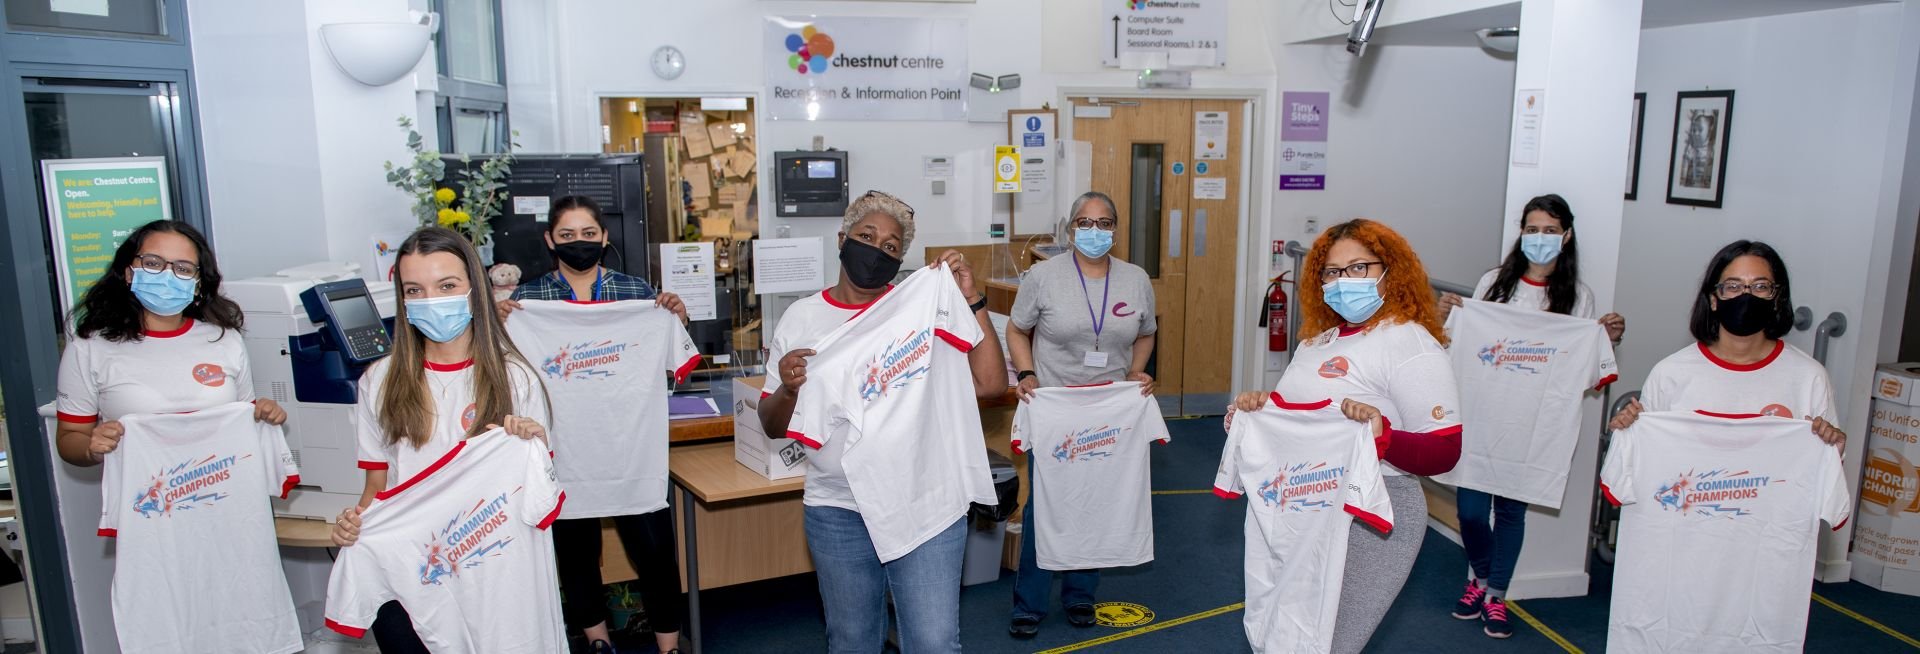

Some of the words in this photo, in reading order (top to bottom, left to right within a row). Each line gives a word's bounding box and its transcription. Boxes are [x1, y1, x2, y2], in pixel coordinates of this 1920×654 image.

[1128, 16, 1164, 24] Computer
[1166, 16, 1184, 24] Suite
[1128, 28, 1149, 36] Board
[1152, 28, 1173, 36] Room
[1128, 40, 1162, 48] Sessional
[832, 54, 898, 68] chestnut
[900, 56, 944, 68] centre
[774, 86, 836, 101] Receion
[841, 87, 850, 99] &
[856, 87, 927, 100] Information
[931, 88, 961, 100] Point
[1291, 102, 1314, 113] Tiny
[1291, 112, 1320, 122] Steps
[64, 179, 76, 187] We
[94, 177, 128, 186] Chestnut
[128, 176, 156, 184] Centre.
[64, 190, 90, 198] Open.
[67, 200, 113, 210] Welcoming,
[114, 198, 142, 207] friendly
[68, 210, 86, 218] here
[88, 210, 96, 218] to
[71, 232, 101, 241] Monday:
[572, 343, 626, 360] COMMUNITY
[883, 327, 931, 368] COMMUNITY
[1506, 346, 1558, 355] COMMUNITY
[566, 354, 620, 371] CHAMPIONS
[880, 342, 930, 384] CHAMPIONS
[1499, 354, 1549, 362] CHAMPIONS
[1077, 428, 1122, 446] COMMUNITY
[1072, 437, 1116, 454] CHAMPIONS
[169, 456, 236, 488] COMMUNITY
[1289, 466, 1344, 486] COMMUNITY
[164, 469, 230, 502] CHAMPIONS
[1282, 479, 1338, 498] CHAMPIONS
[1696, 476, 1770, 492] COMMUNITY
[1685, 488, 1758, 504] CHAMPIONS
[447, 492, 508, 546] COMMUNITY
[447, 510, 508, 562] CHAMPIONS
[1878, 543, 1892, 552] and
[1894, 548, 1916, 556] pass
[1874, 550, 1908, 564] families
